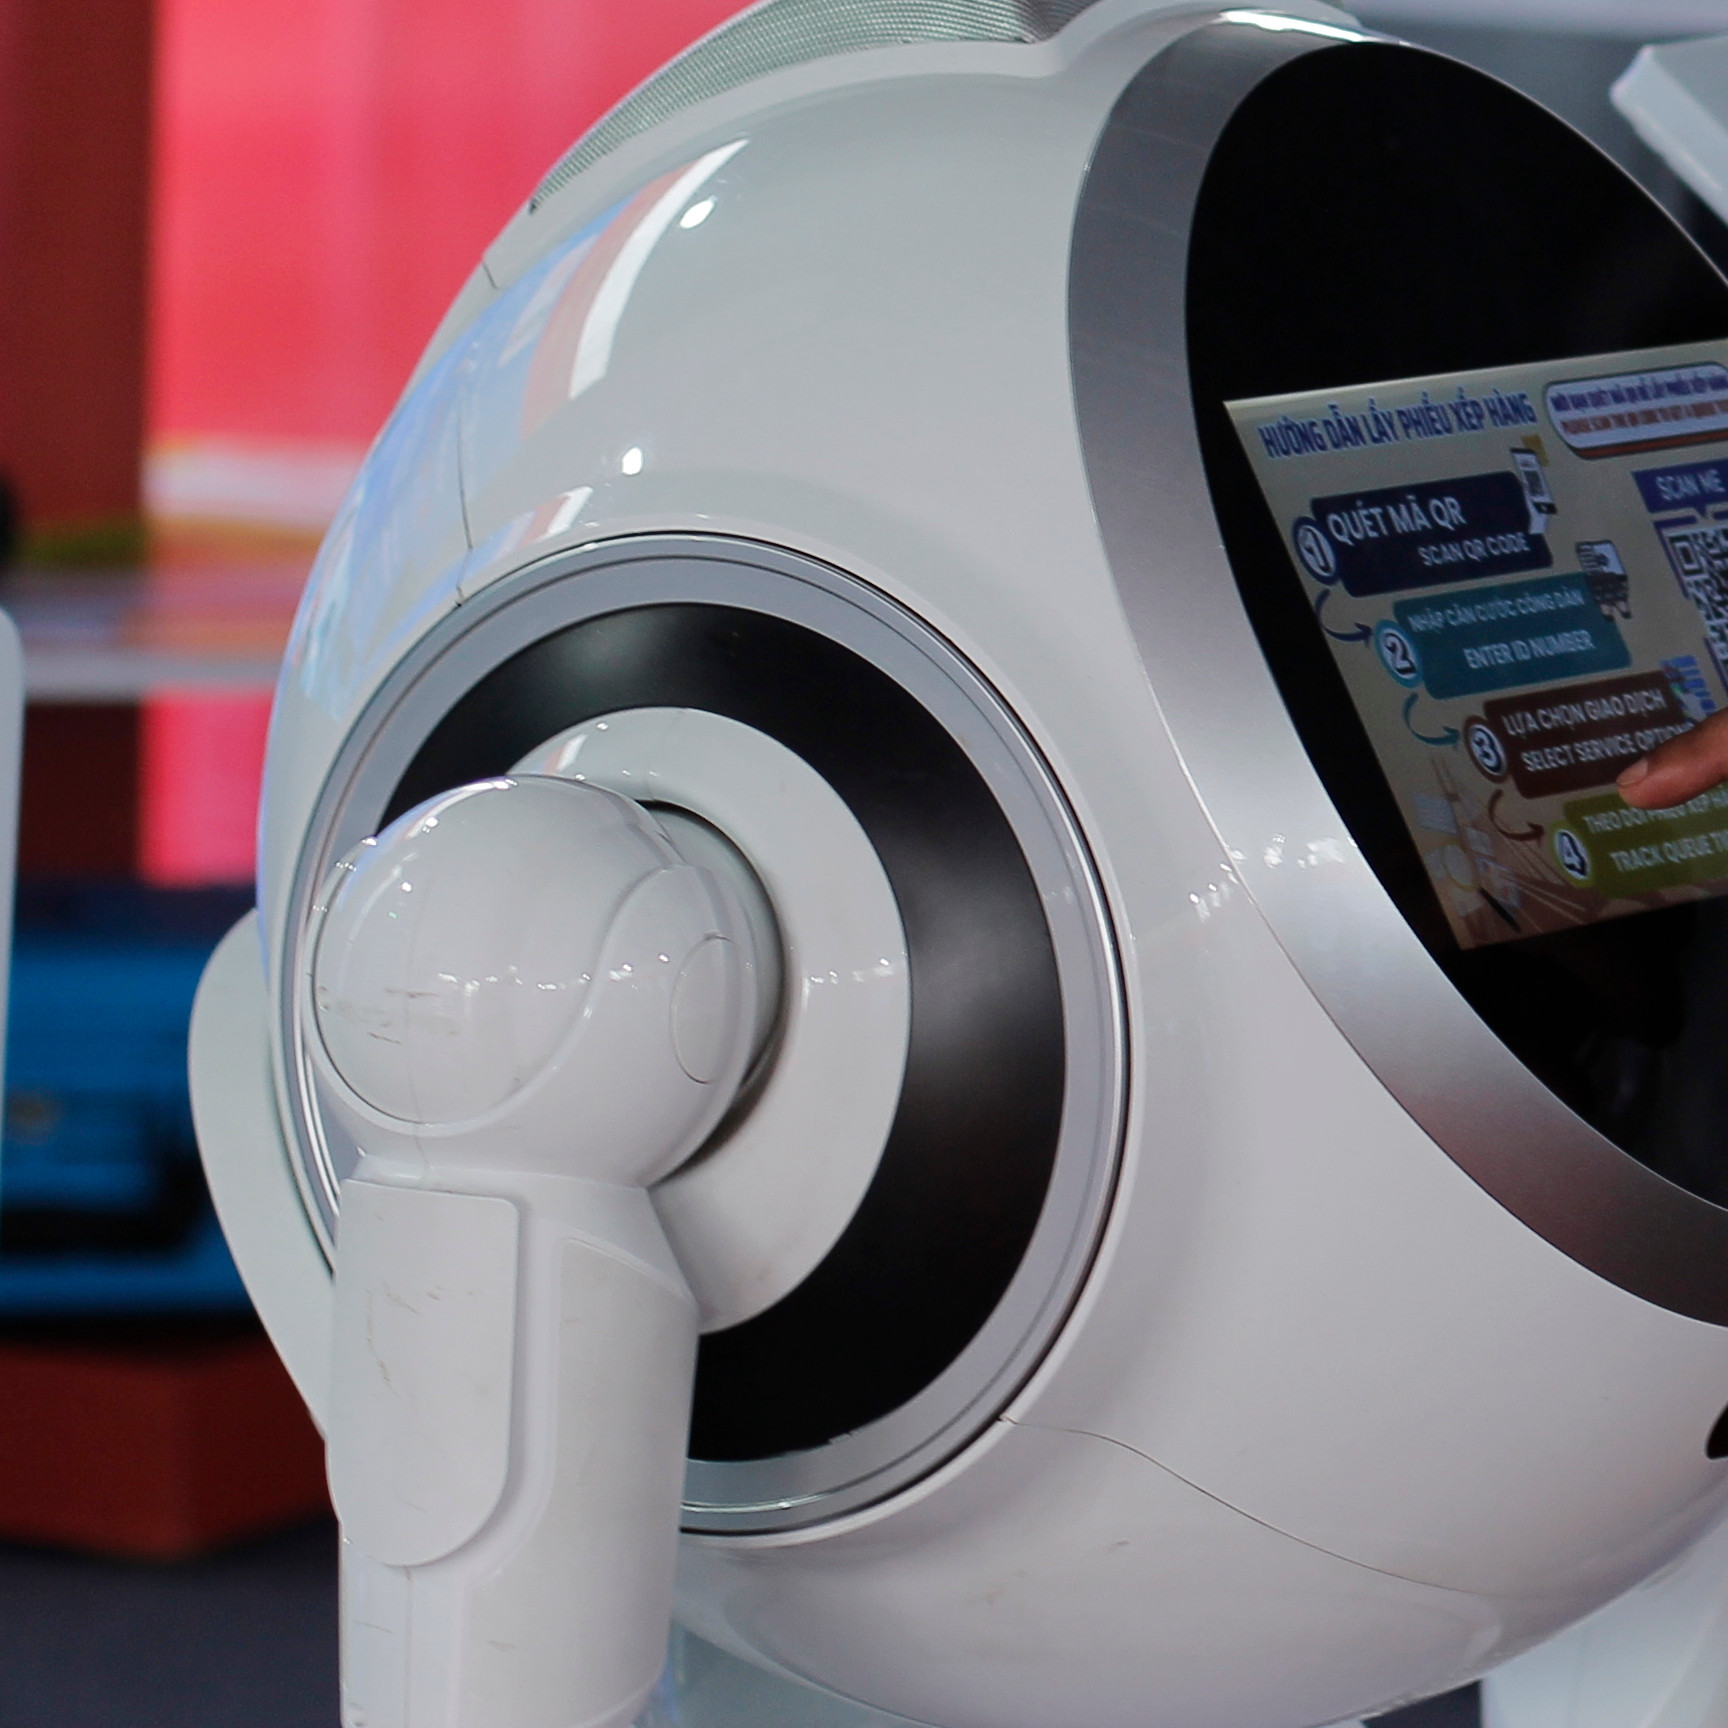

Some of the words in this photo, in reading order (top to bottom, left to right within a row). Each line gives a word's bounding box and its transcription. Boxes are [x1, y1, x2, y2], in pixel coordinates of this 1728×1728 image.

[1321, 401, 1368, 449] DẪN
[1362, 396, 1400, 444] LẤY
[1398, 389, 1454, 440] PHIẾU
[1449, 386, 1487, 433] XẾP
[1482, 387, 1537, 428] HÀNG
[1655, 473, 1700, 501] SCAN
[1697, 469, 1726, 493] ME
[1326, 499, 1388, 546] QUÉT
[1388, 495, 1432, 534] MÃ
[1429, 496, 1467, 532] QR
[1417, 541, 1464, 566] SCAN
[1463, 538, 1488, 560] QR
[1486, 532, 1530, 555] CODE
[1384, 631, 1417, 675] 2
[1463, 643, 1514, 669] ENTER
[1512, 639, 1531, 661] ID
[1528, 629, 1596, 658] NUMBER
[1537, 703, 1587, 731] CHỌN
[1586, 696, 1625, 721] GIAO
[1623, 689, 1667, 717] DỊCH
[1472, 728, 1503, 774] 3
[1521, 745, 1577, 772] SELECT
[1575, 733, 1637, 762] SERVICE
[1582, 811, 1622, 834] THEO
[1557, 830, 1588, 877] 4
[1610, 845, 1665, 872] TRACK
[1663, 835, 1713, 863] QUEUE
